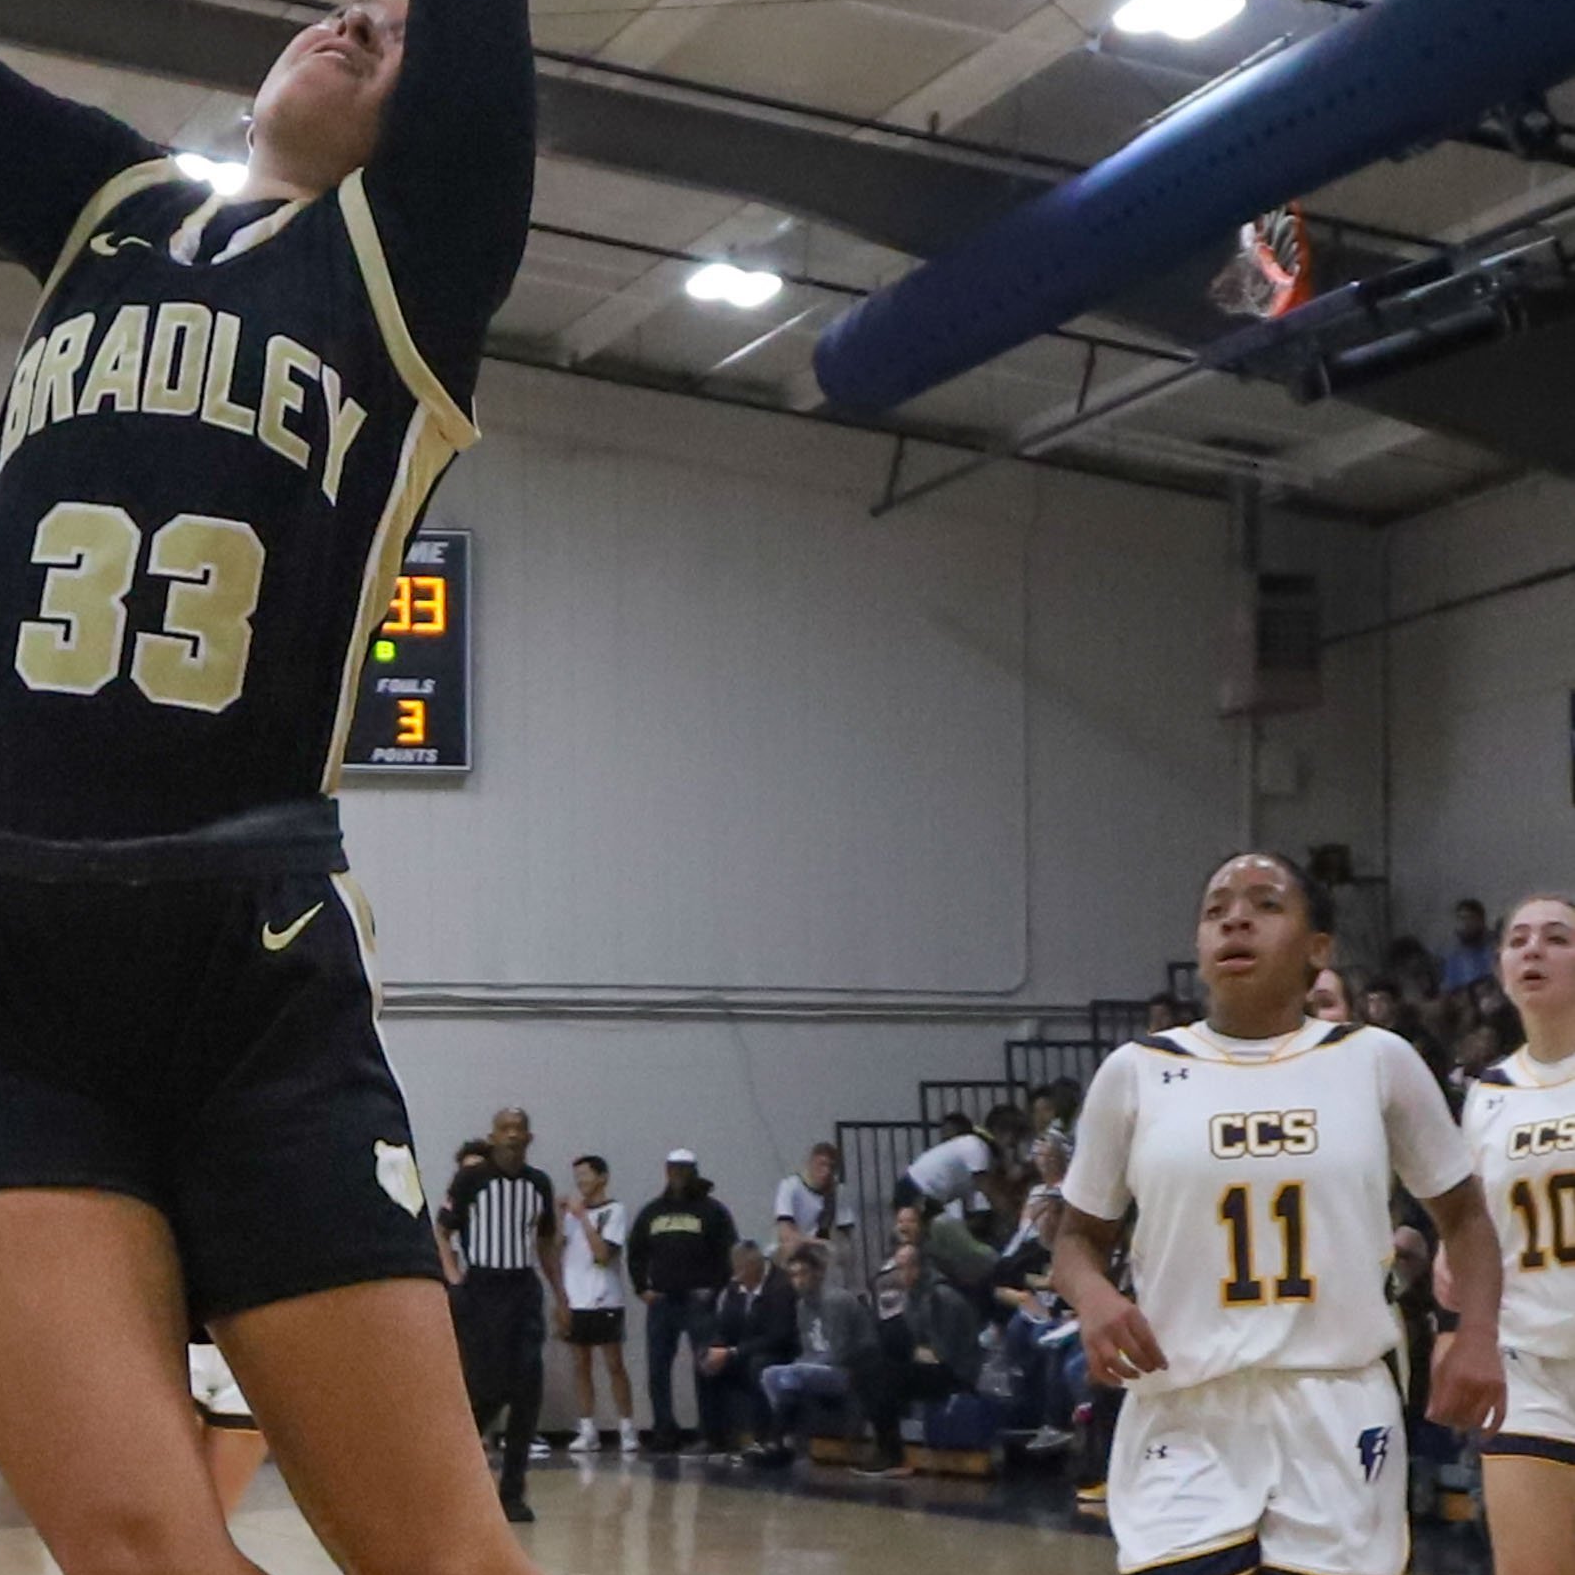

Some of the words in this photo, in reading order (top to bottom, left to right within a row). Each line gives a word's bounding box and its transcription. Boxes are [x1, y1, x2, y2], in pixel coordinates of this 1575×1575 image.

[405, 541, 449, 564] ME
[14, 502, 266, 714] 33
[396, 699, 426, 744] 3
[372, 748, 439, 763] POINTS
[1209, 1108, 1318, 1160] CCS
[1216, 1180, 1316, 1309] 11
